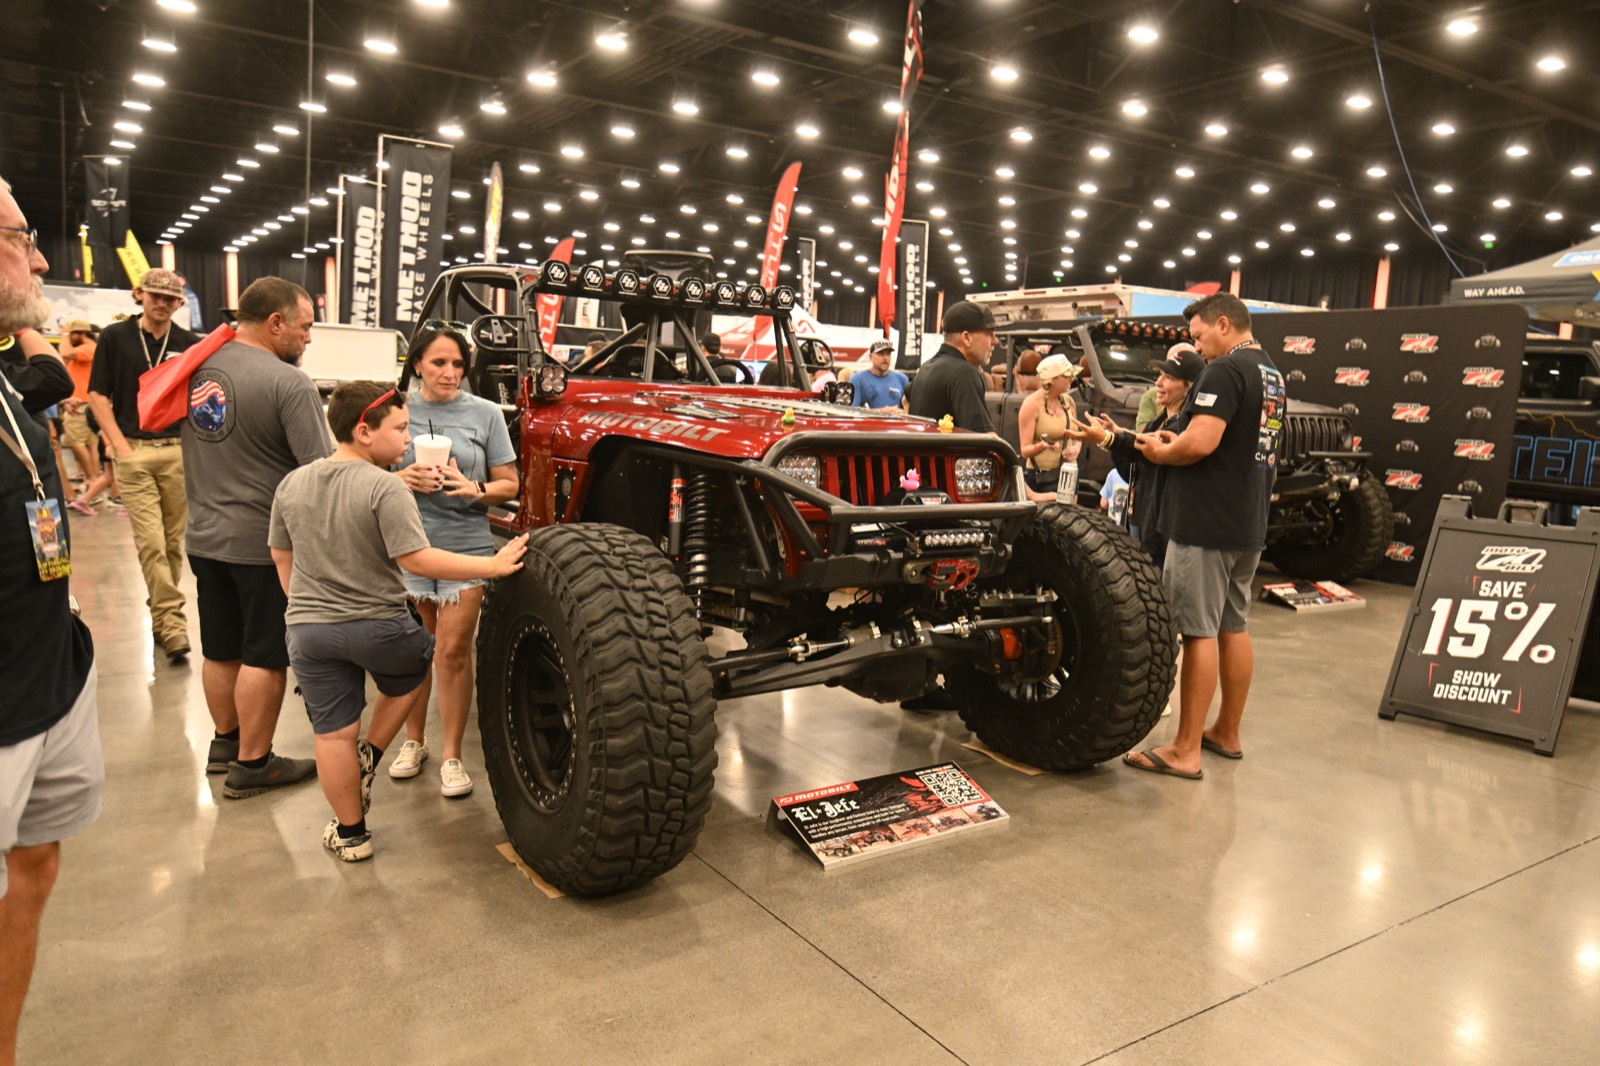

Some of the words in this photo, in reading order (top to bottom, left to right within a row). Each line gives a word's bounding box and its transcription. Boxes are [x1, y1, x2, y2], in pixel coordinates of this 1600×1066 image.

[416, 174, 434, 260] WHEELS
[395, 170, 422, 322] METHOD
[351, 205, 376, 326] METHOD
[412, 271, 426, 323] RACE
[904, 244, 917, 356] METHOD
[1464, 288, 1485, 298] WAY
[577, 411, 731, 442] MOTOBILT
[1512, 434, 1600, 487] TEI
[1482, 546, 1528, 554] MOTO
[1503, 563, 1540, 573] BILT
[1478, 580, 1528, 599] SAVE
[1422, 598, 1557, 665] 15%
[1452, 669, 1502, 688] SHOW
[1433, 683, 1513, 706] DISCOUNT
[795, 783, 852, 801] MOTOBILT
[791, 805, 819, 822] El
[819, 798, 860, 818] Jefe
